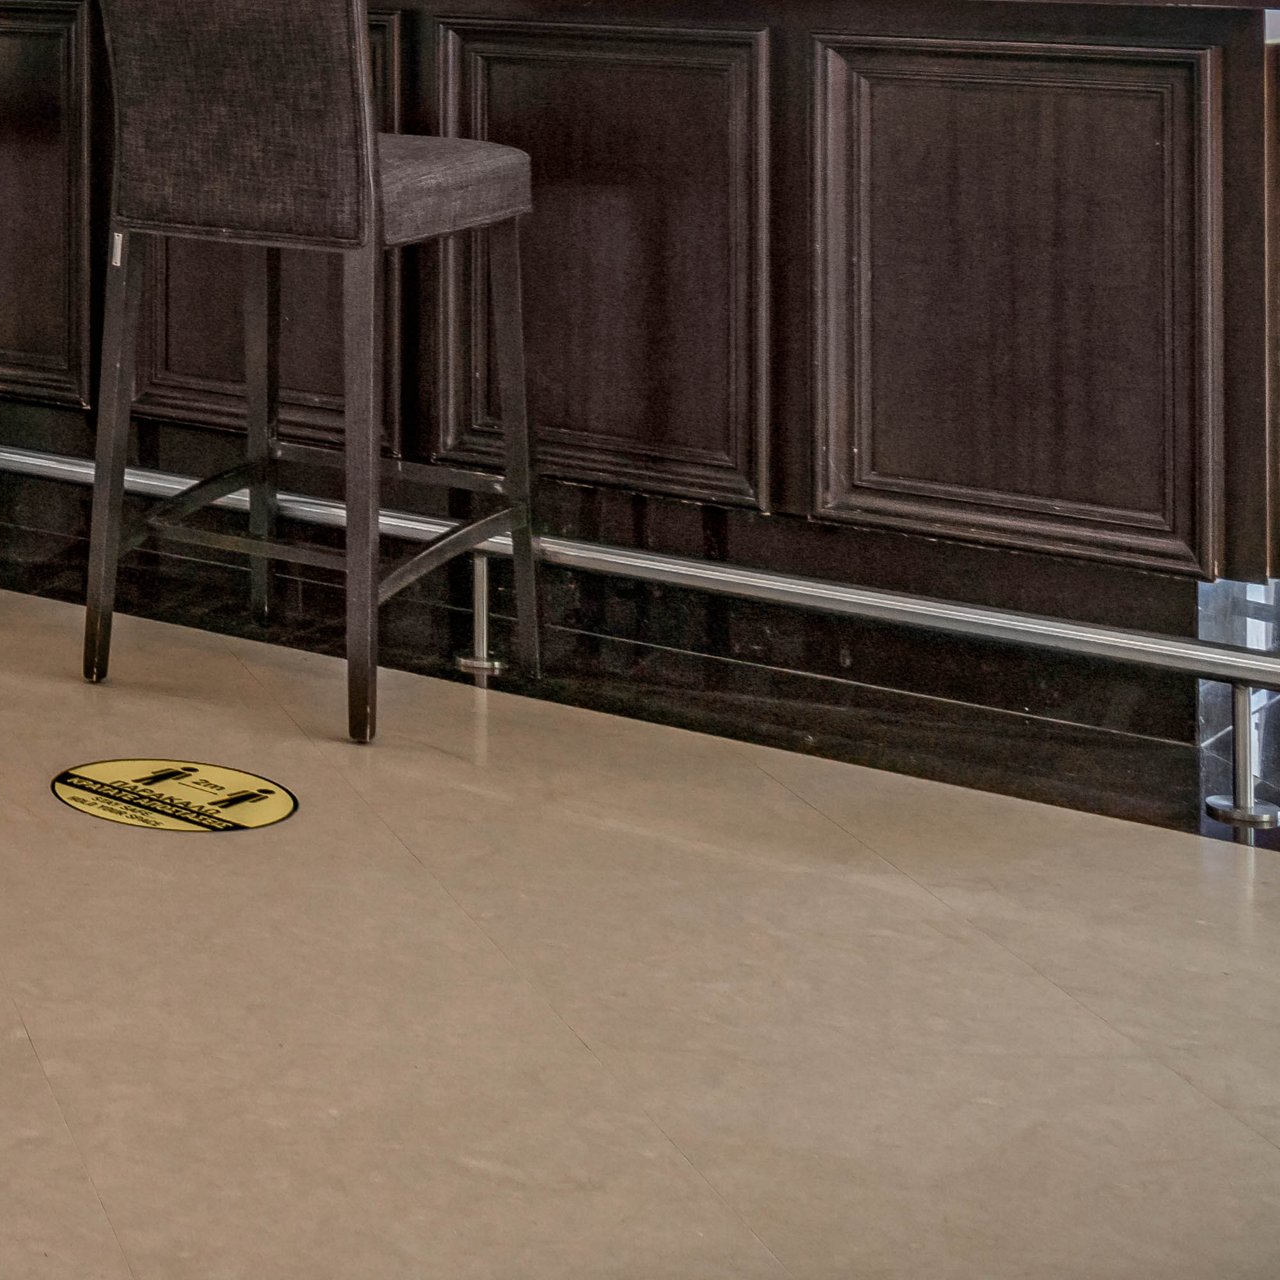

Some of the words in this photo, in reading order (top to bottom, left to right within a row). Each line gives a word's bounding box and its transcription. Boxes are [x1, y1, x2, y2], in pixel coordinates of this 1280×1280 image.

[67, 777, 140, 800] ΚΡΑΤΑΤΕ
[192, 779, 225, 791] 2m
[91, 796, 120, 807] STAY
[109, 780, 222, 815] ΠΑΡΑΚΑΛΩ
